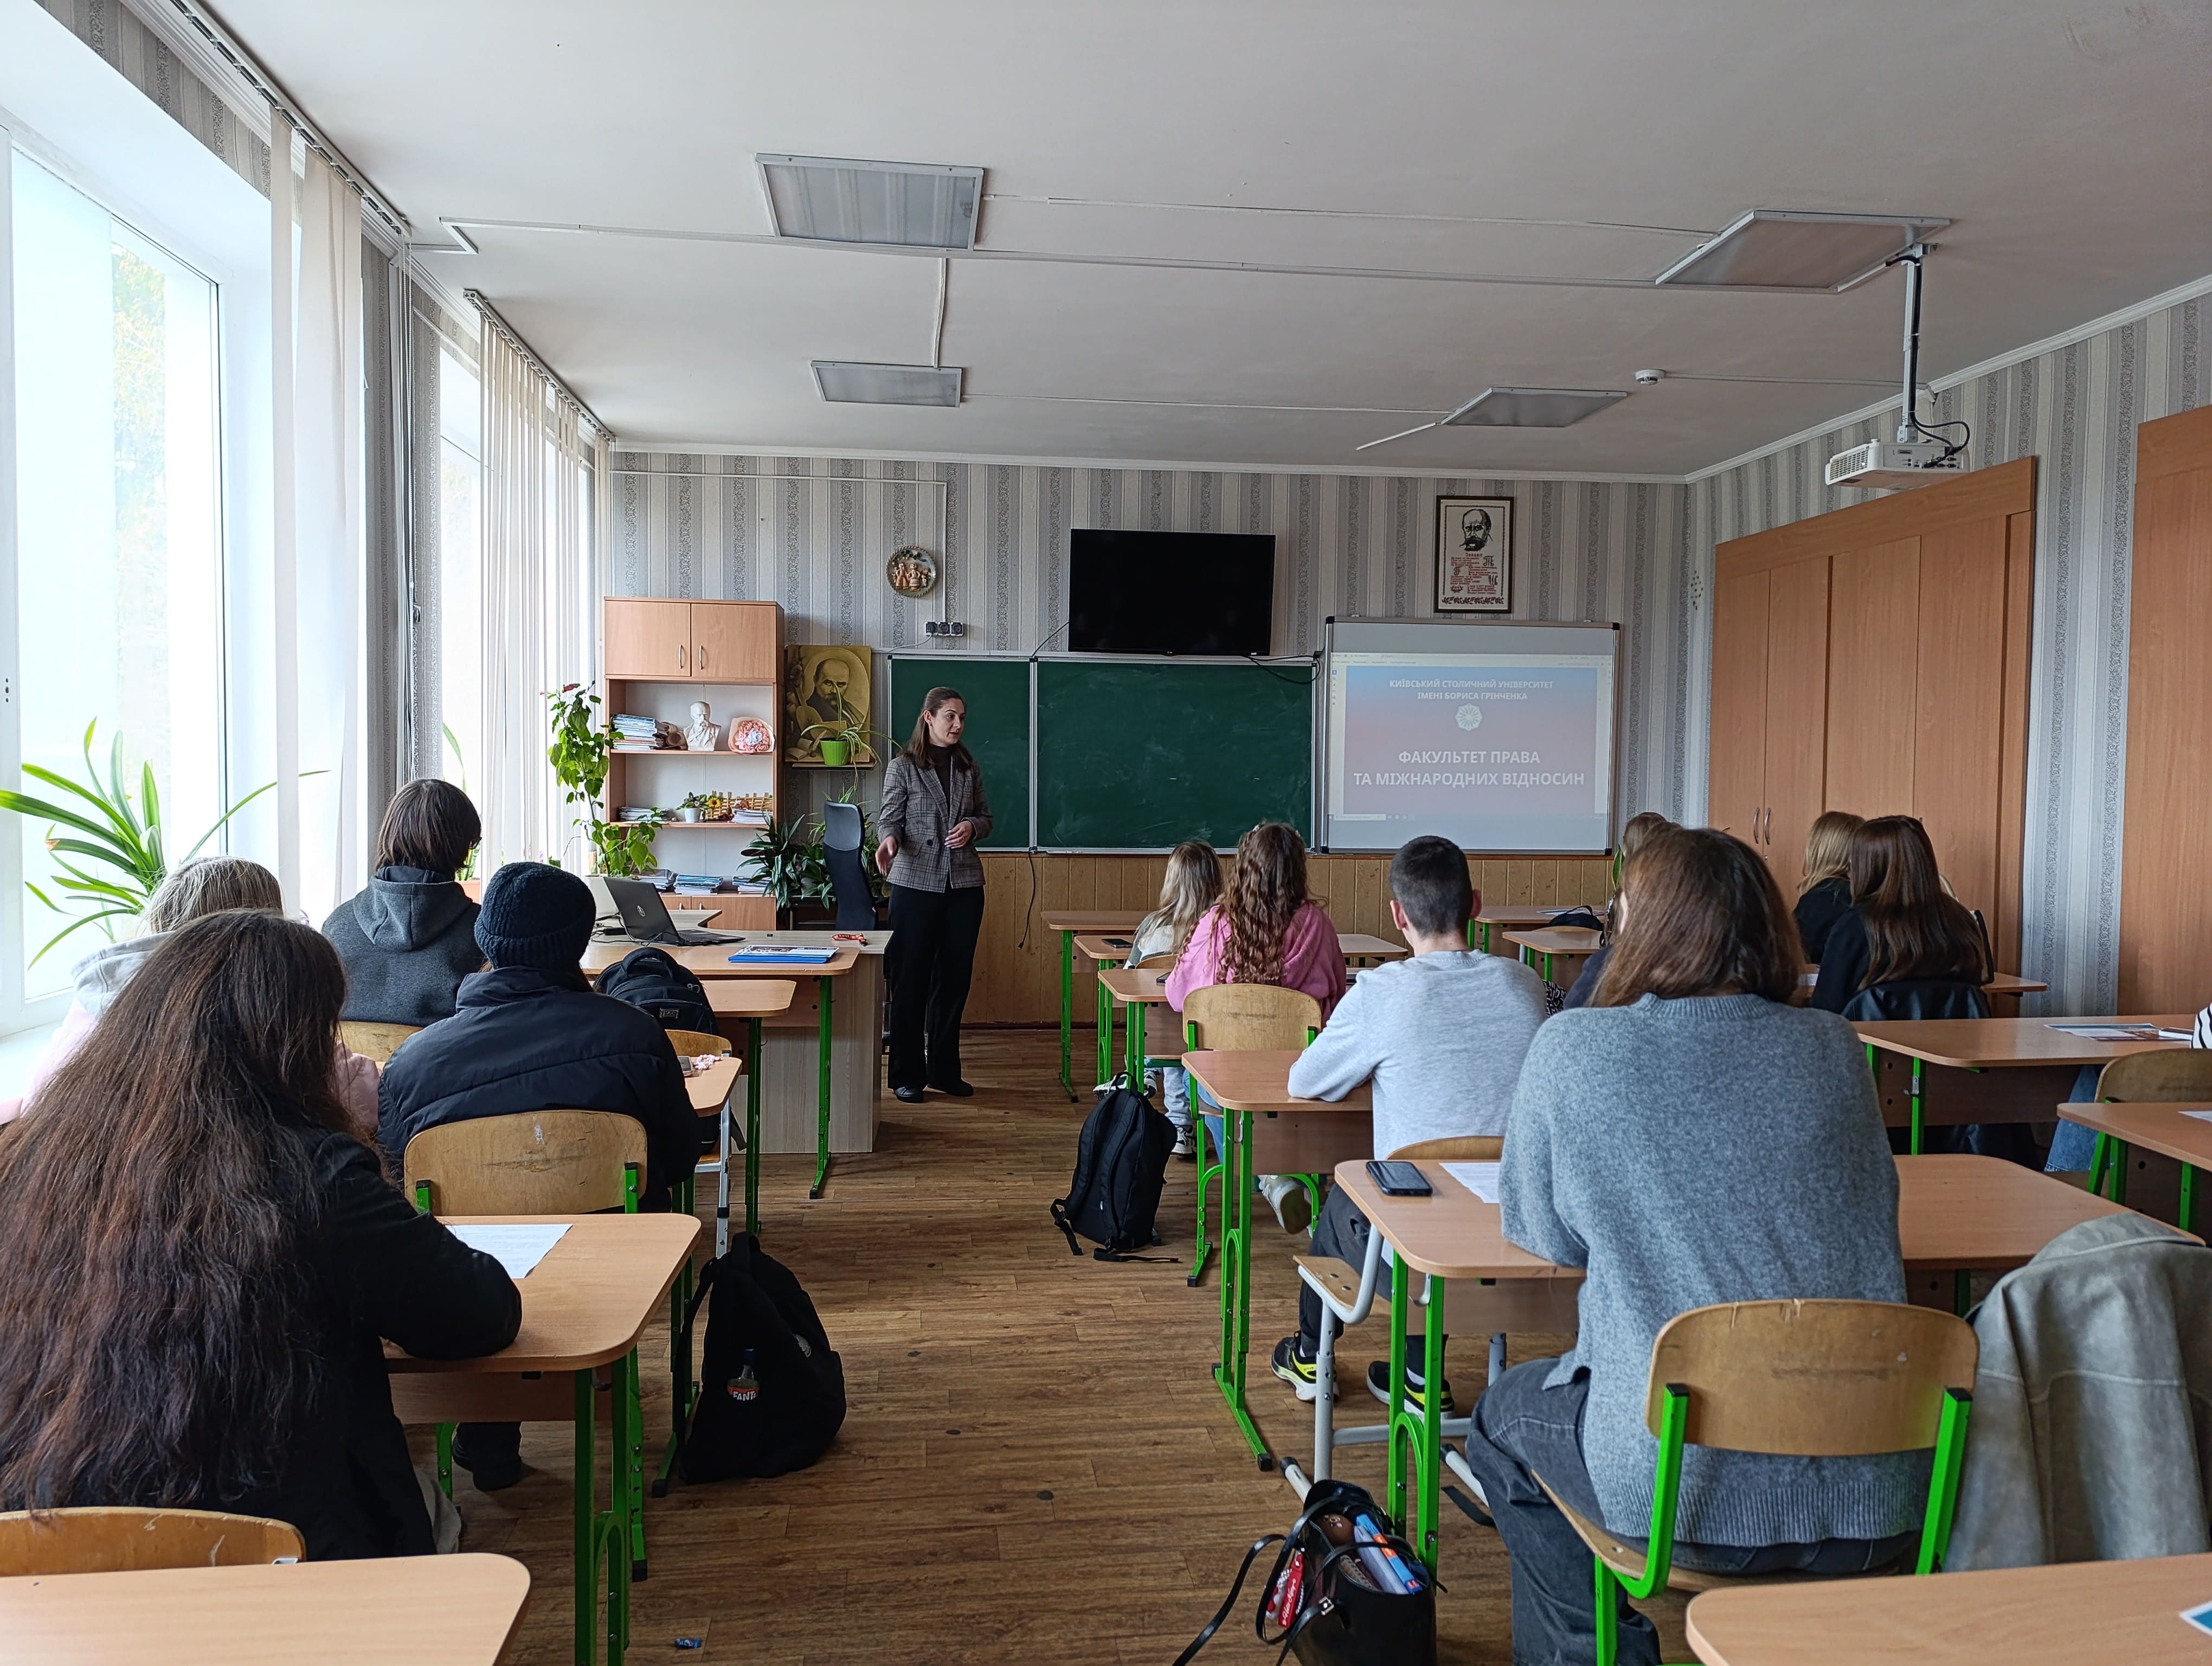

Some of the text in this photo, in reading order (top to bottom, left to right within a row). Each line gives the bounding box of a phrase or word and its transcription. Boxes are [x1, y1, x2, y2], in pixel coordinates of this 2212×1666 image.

[1389, 679, 1554, 689] КИЇВСЬКИЙ СТОЛИЧНИЙ УНІВЕРСИТЕТ
[1444, 692, 1479, 700] БОРИСА
[1481, 692, 1528, 700] ГРІНЧЕНКА
[1398, 751, 1540, 764] ФАКУЛЬТЕТ ПРАВА
[1353, 773, 1584, 788] ТА МІЖНАРОДНИХ ВІДНОСИН
